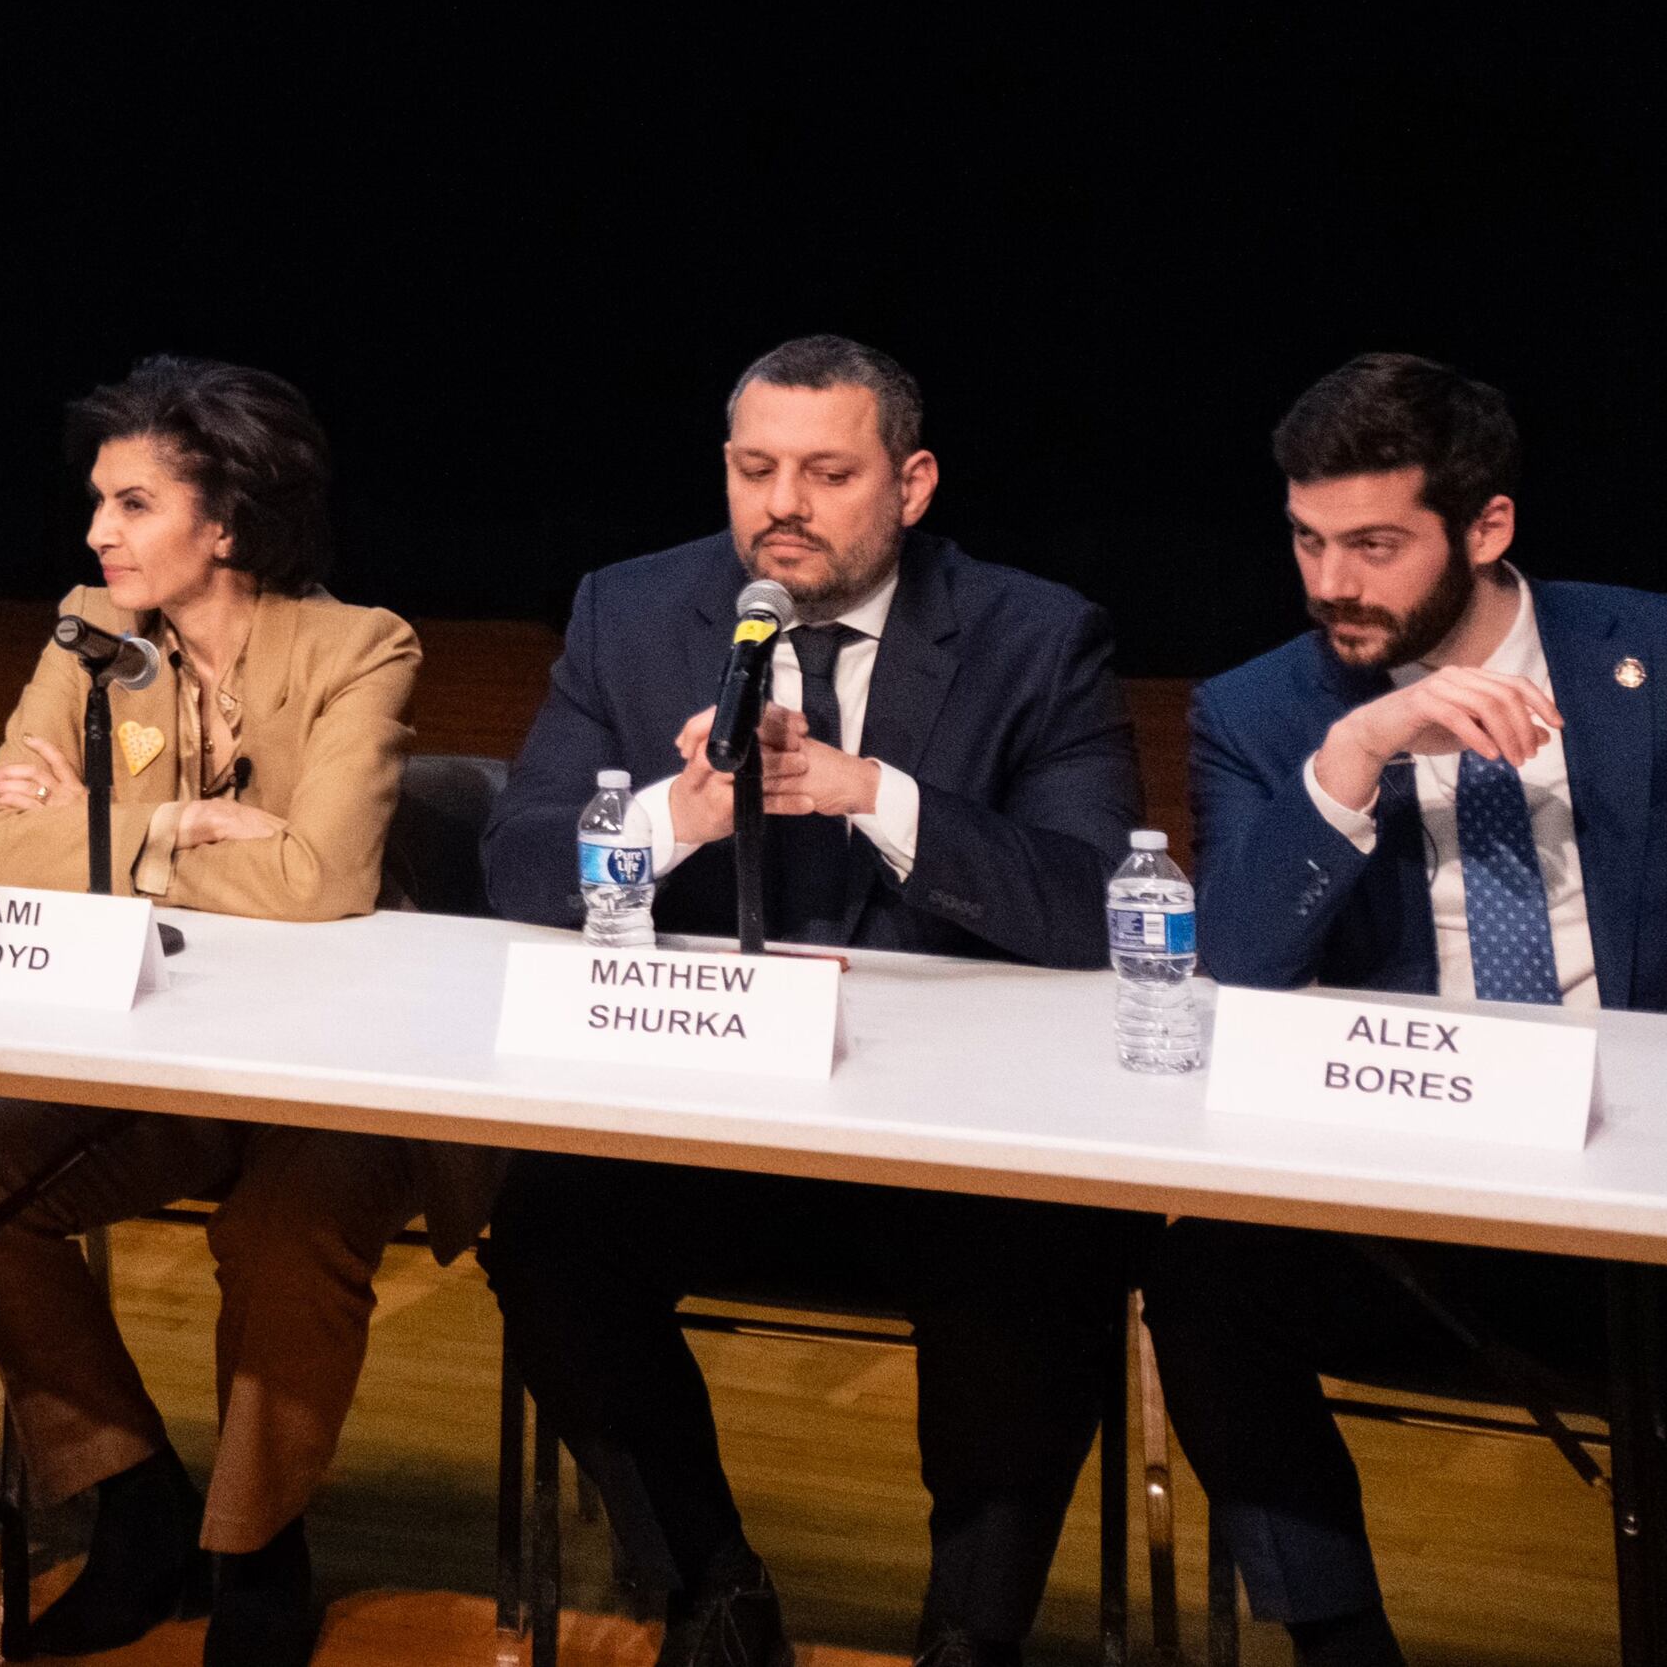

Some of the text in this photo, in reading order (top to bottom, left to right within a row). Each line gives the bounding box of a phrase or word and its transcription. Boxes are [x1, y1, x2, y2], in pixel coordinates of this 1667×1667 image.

[590, 959, 756, 993] MATHEW
[587, 1004, 747, 1039] SHURKA
[1346, 1015, 1460, 1054] ALEX
[1324, 1062, 1473, 1103] BORES
